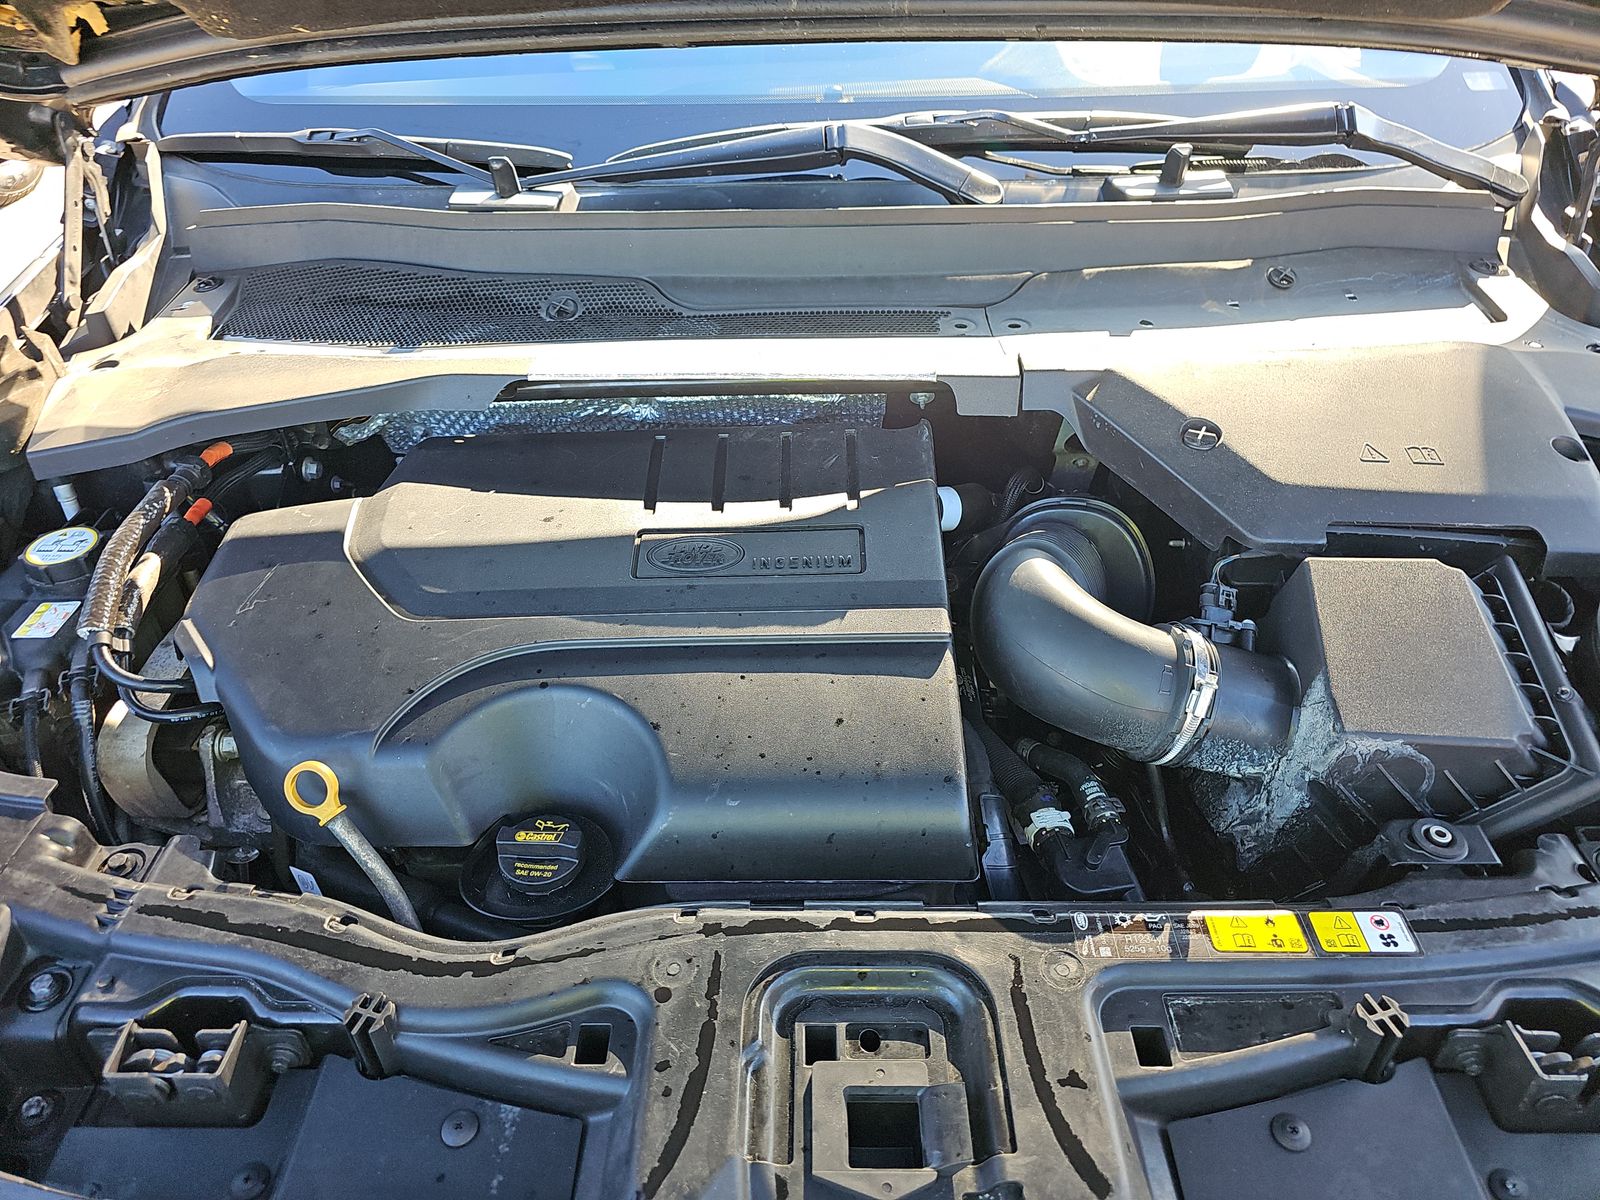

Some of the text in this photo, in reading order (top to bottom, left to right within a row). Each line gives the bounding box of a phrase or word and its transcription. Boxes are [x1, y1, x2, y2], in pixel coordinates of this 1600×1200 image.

[752, 555, 853, 570] INGENIUM
[525, 831, 557, 841] Castrol
[514, 862, 559, 871] recommended
[529, 870, 553, 878] 0W-20
[1124, 945, 1146, 954] 525g
[1157, 945, 1173, 954] 10g
